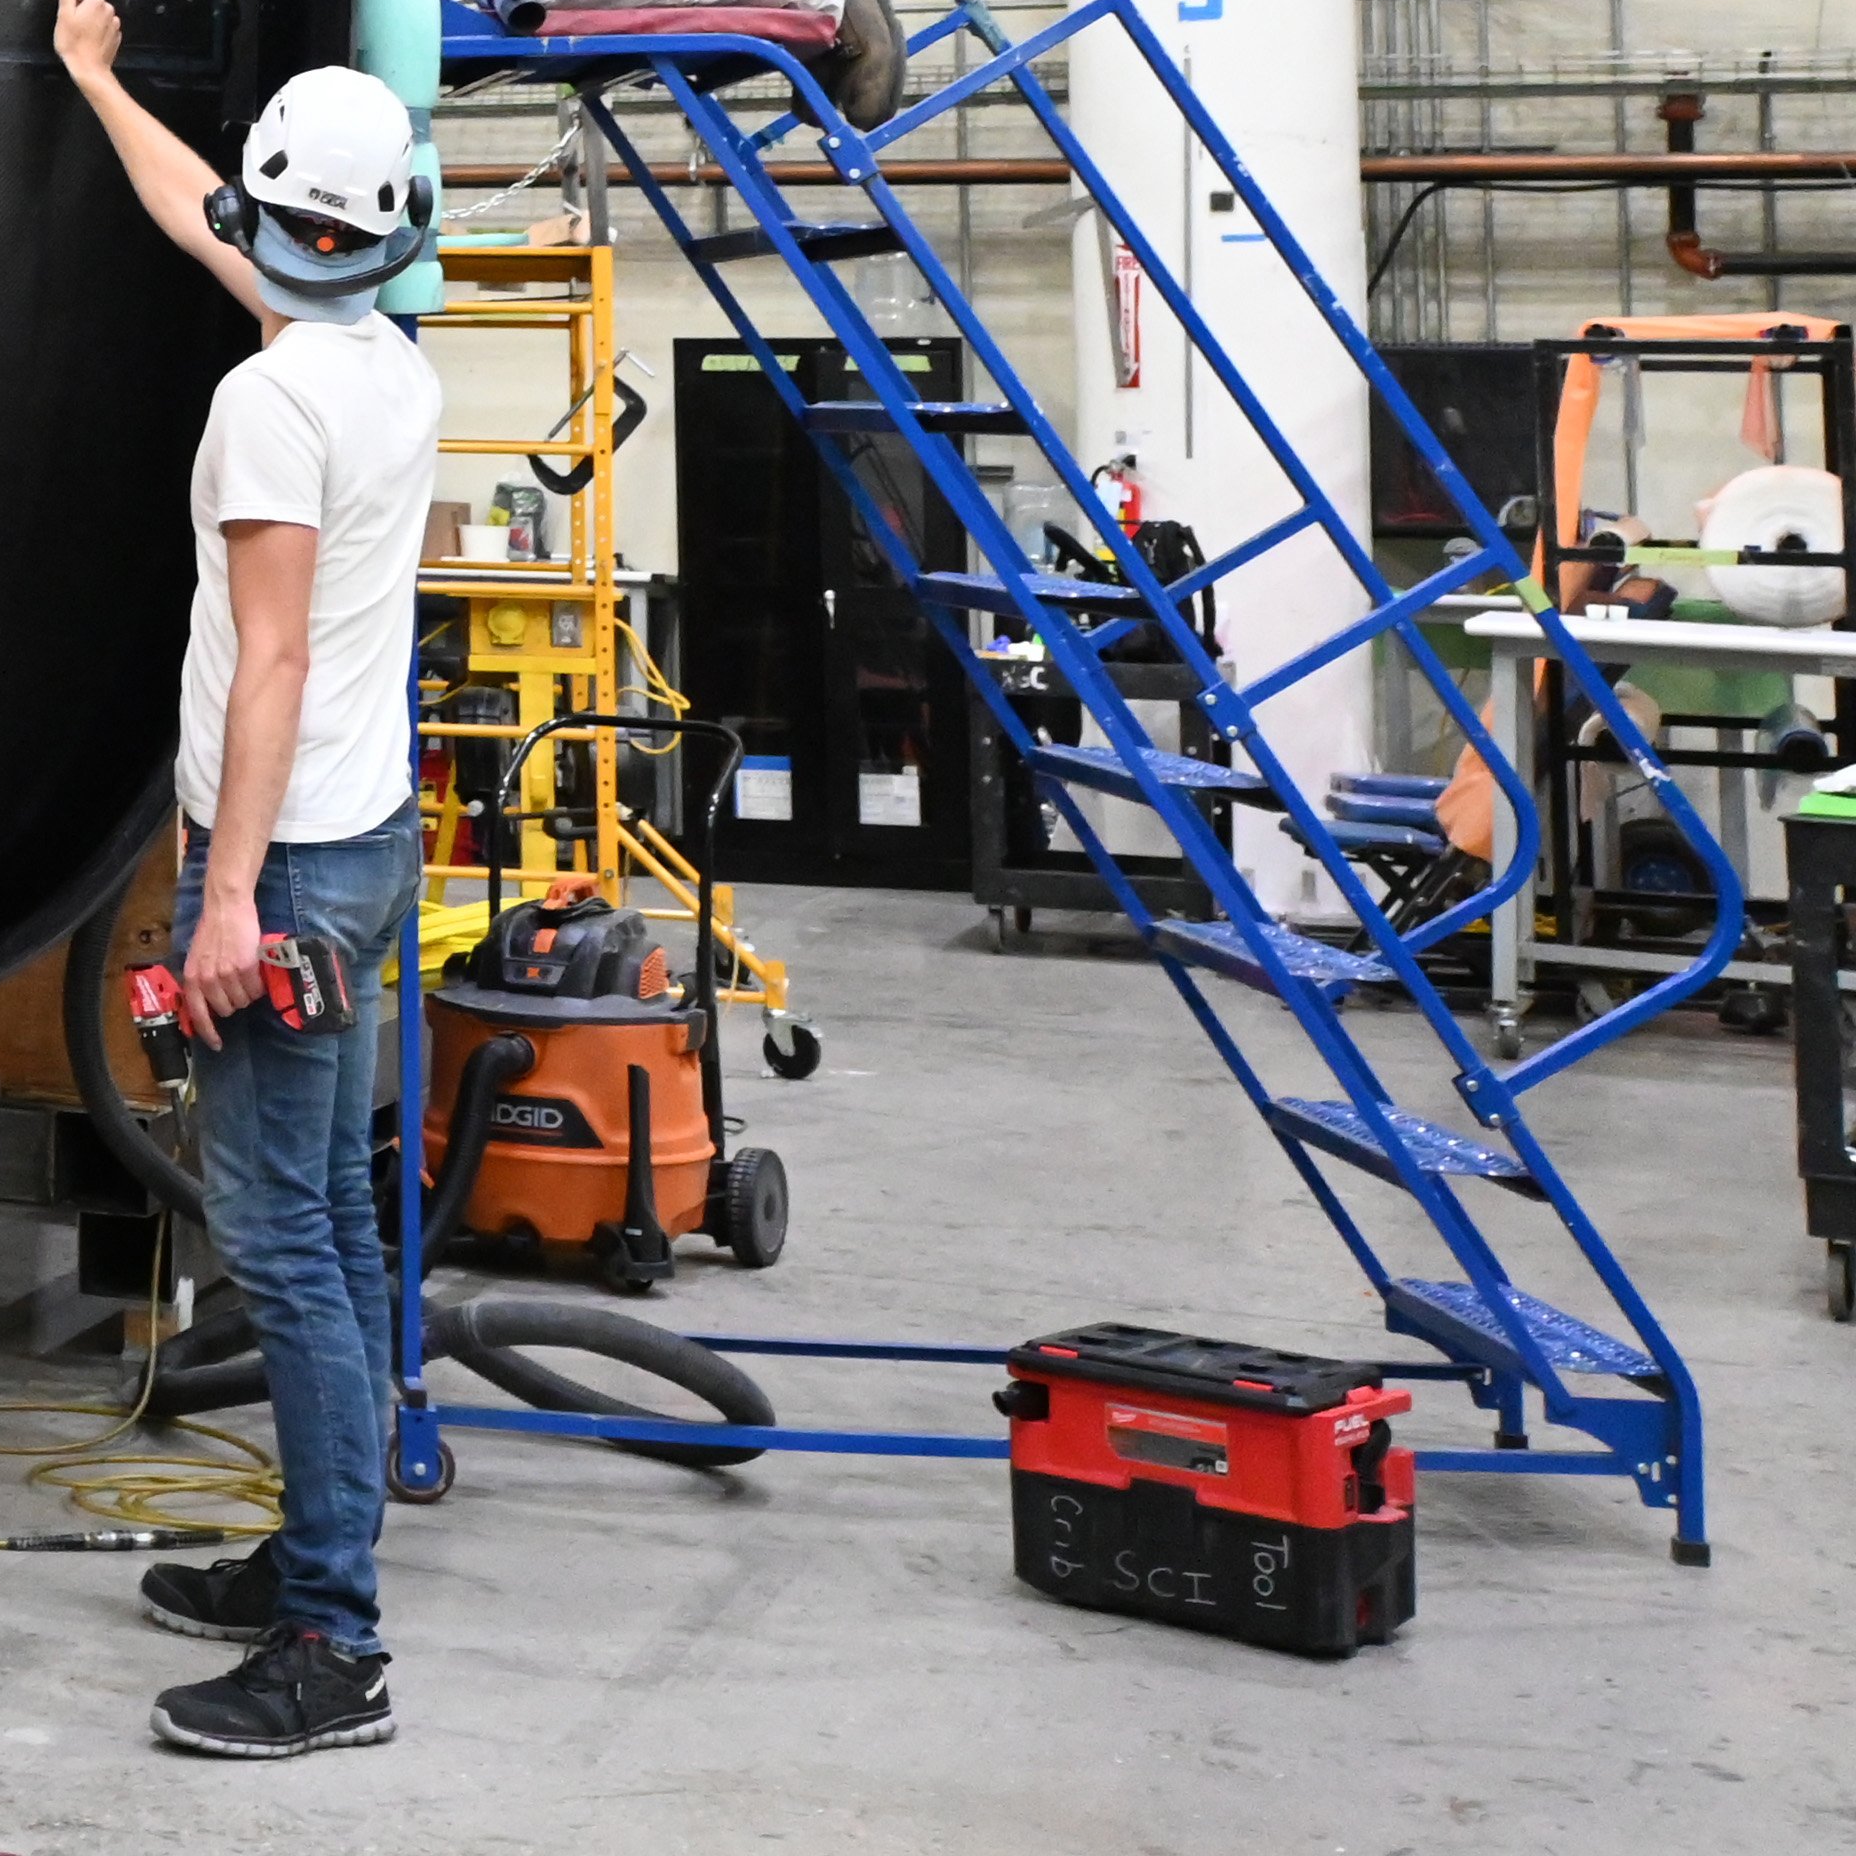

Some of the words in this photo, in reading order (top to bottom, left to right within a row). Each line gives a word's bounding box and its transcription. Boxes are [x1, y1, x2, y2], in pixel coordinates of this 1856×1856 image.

[491, 1103, 563, 1129] IDGID
[1111, 1549, 1217, 1606] SCI
[1250, 1534, 1289, 1610] Tool
